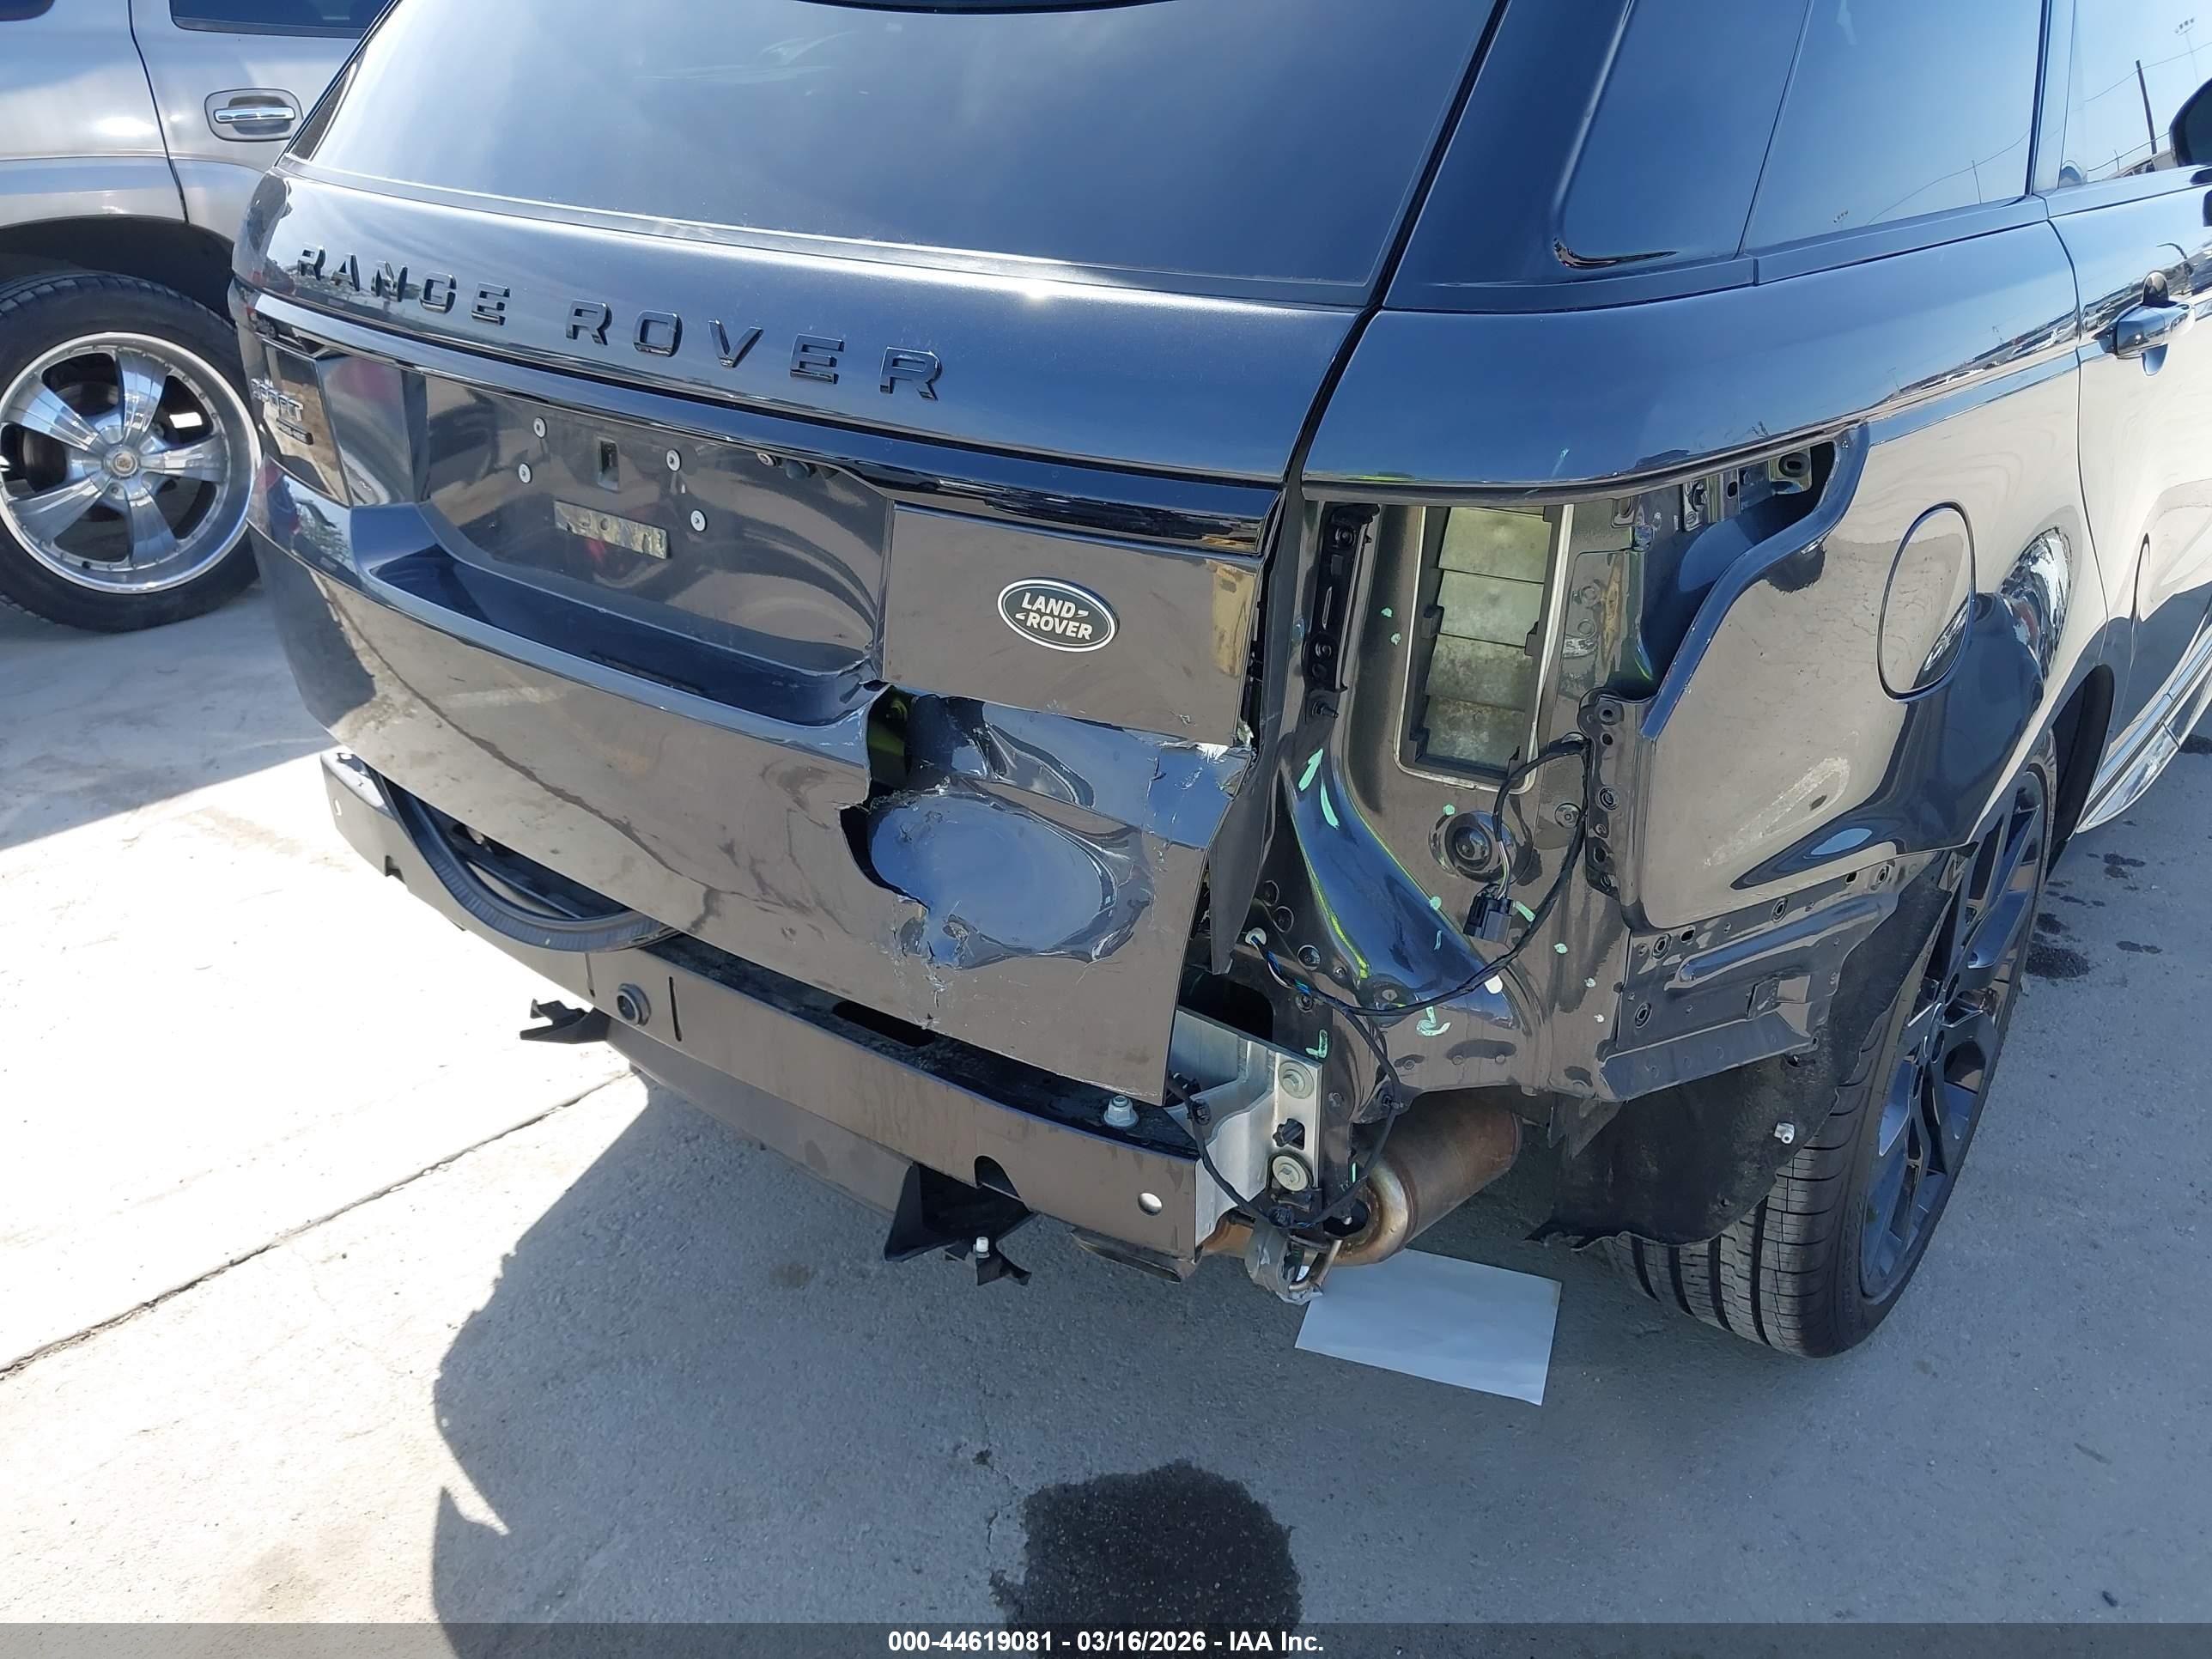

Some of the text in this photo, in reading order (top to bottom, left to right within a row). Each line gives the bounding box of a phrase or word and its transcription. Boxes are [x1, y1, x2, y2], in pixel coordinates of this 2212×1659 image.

[296, 241, 943, 401] RANGE ROVER
[1021, 592, 1077, 618] LAND
[1025, 611, 1094, 641] ROVER
